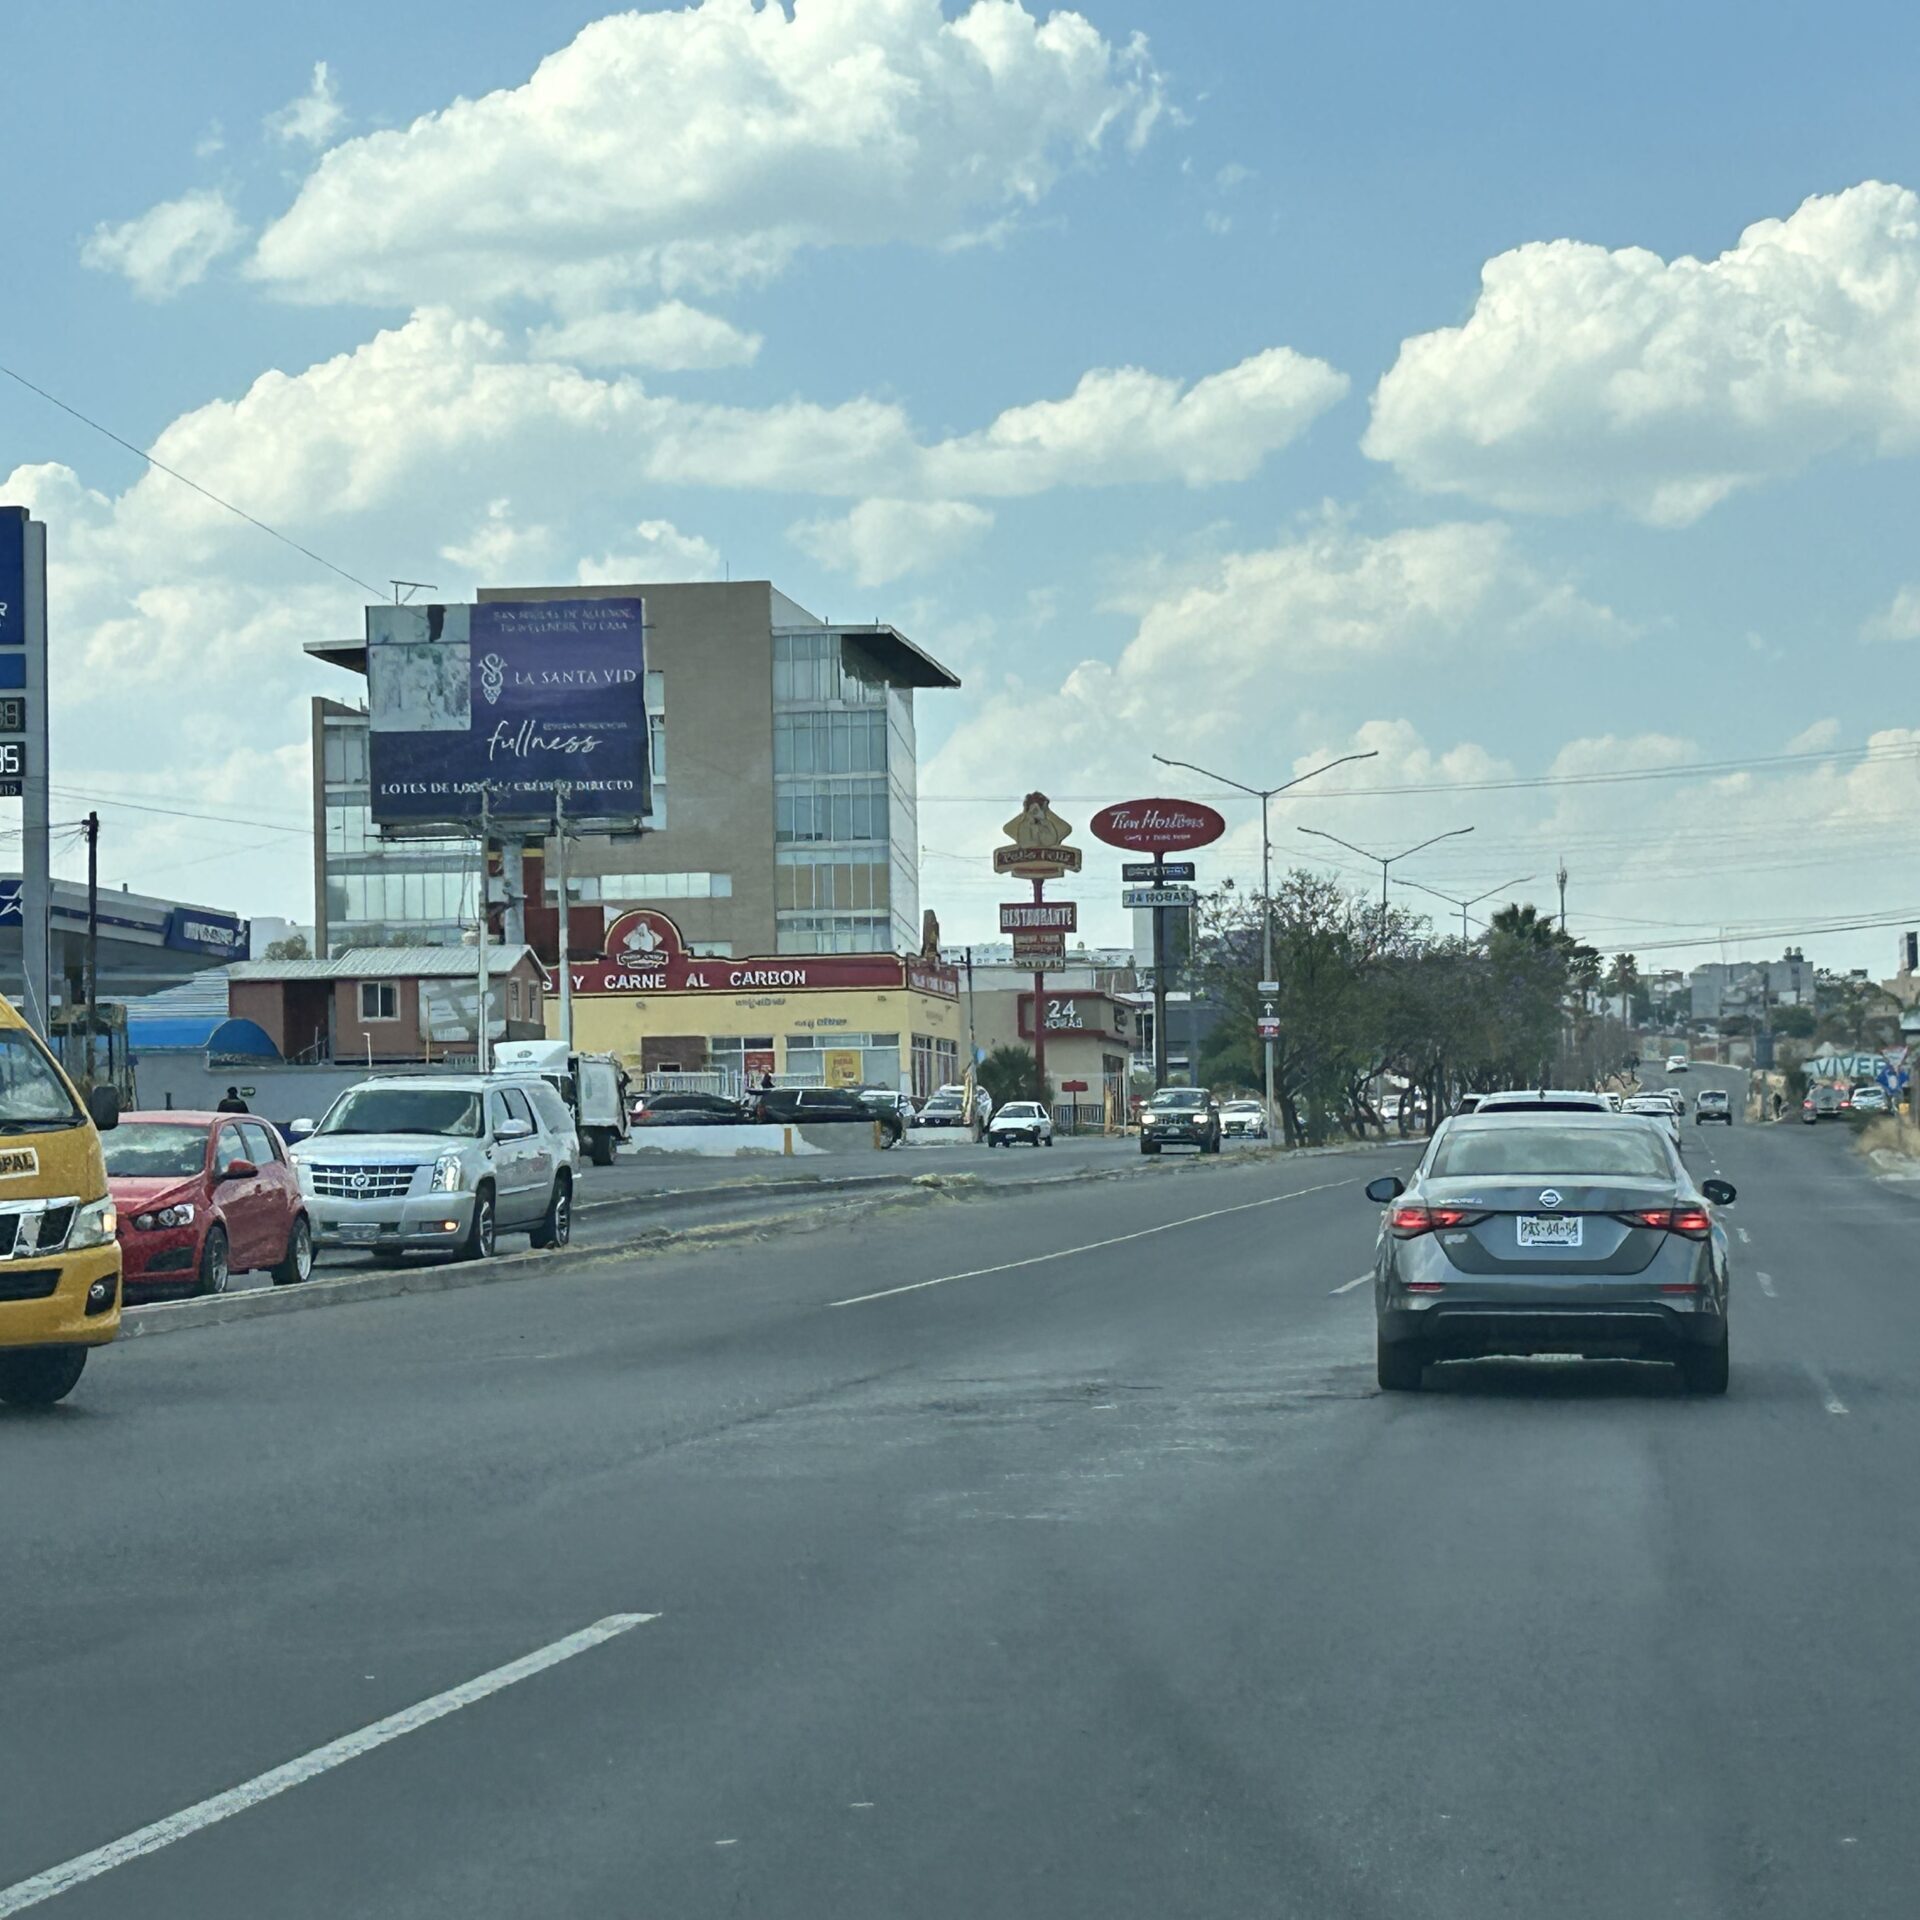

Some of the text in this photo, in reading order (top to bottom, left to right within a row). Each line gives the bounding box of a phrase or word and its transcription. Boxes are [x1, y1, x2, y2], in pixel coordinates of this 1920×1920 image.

[515, 669, 637, 685] LA SANTA VID
[487, 719, 603, 761] fullness
[381, 783, 427, 795] LOTES
[431, 782, 449, 794] DE
[576, 780, 633, 791] DIRECTO
[1109, 810, 1205, 829] Tim Hortons
[1001, 907, 1072, 927] RESTAURANTE
[572, 975, 585, 990] Y
[604, 973, 667, 989] CARNE
[686, 973, 710, 988] AL
[729, 970, 806, 986] CARBON
[1048, 999, 1076, 1018] 24
